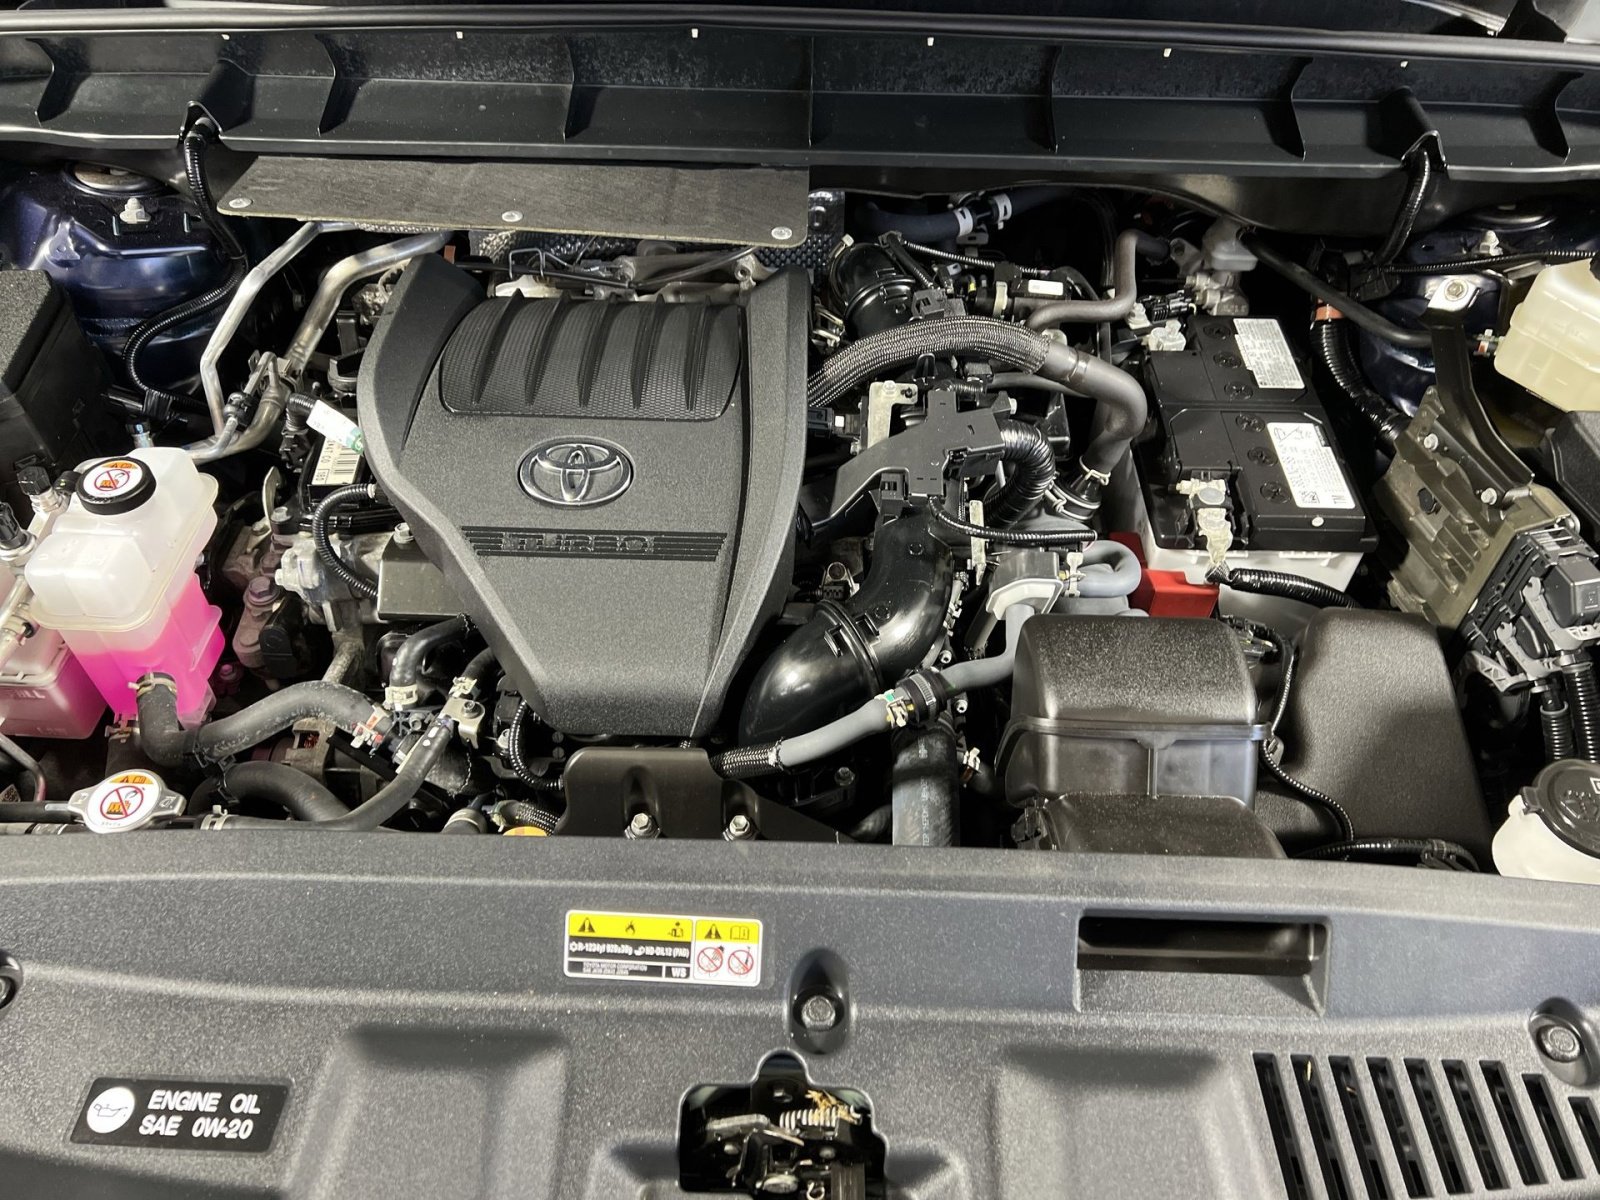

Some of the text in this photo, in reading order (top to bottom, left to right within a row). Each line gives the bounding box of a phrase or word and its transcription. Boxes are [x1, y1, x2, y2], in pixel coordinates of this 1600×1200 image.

[503, 532, 654, 553] TURBO
[671, 967, 687, 978] WS
[148, 1089, 261, 1115] ENGINE OIL
[139, 1114, 254, 1139] SAE 0W-20
